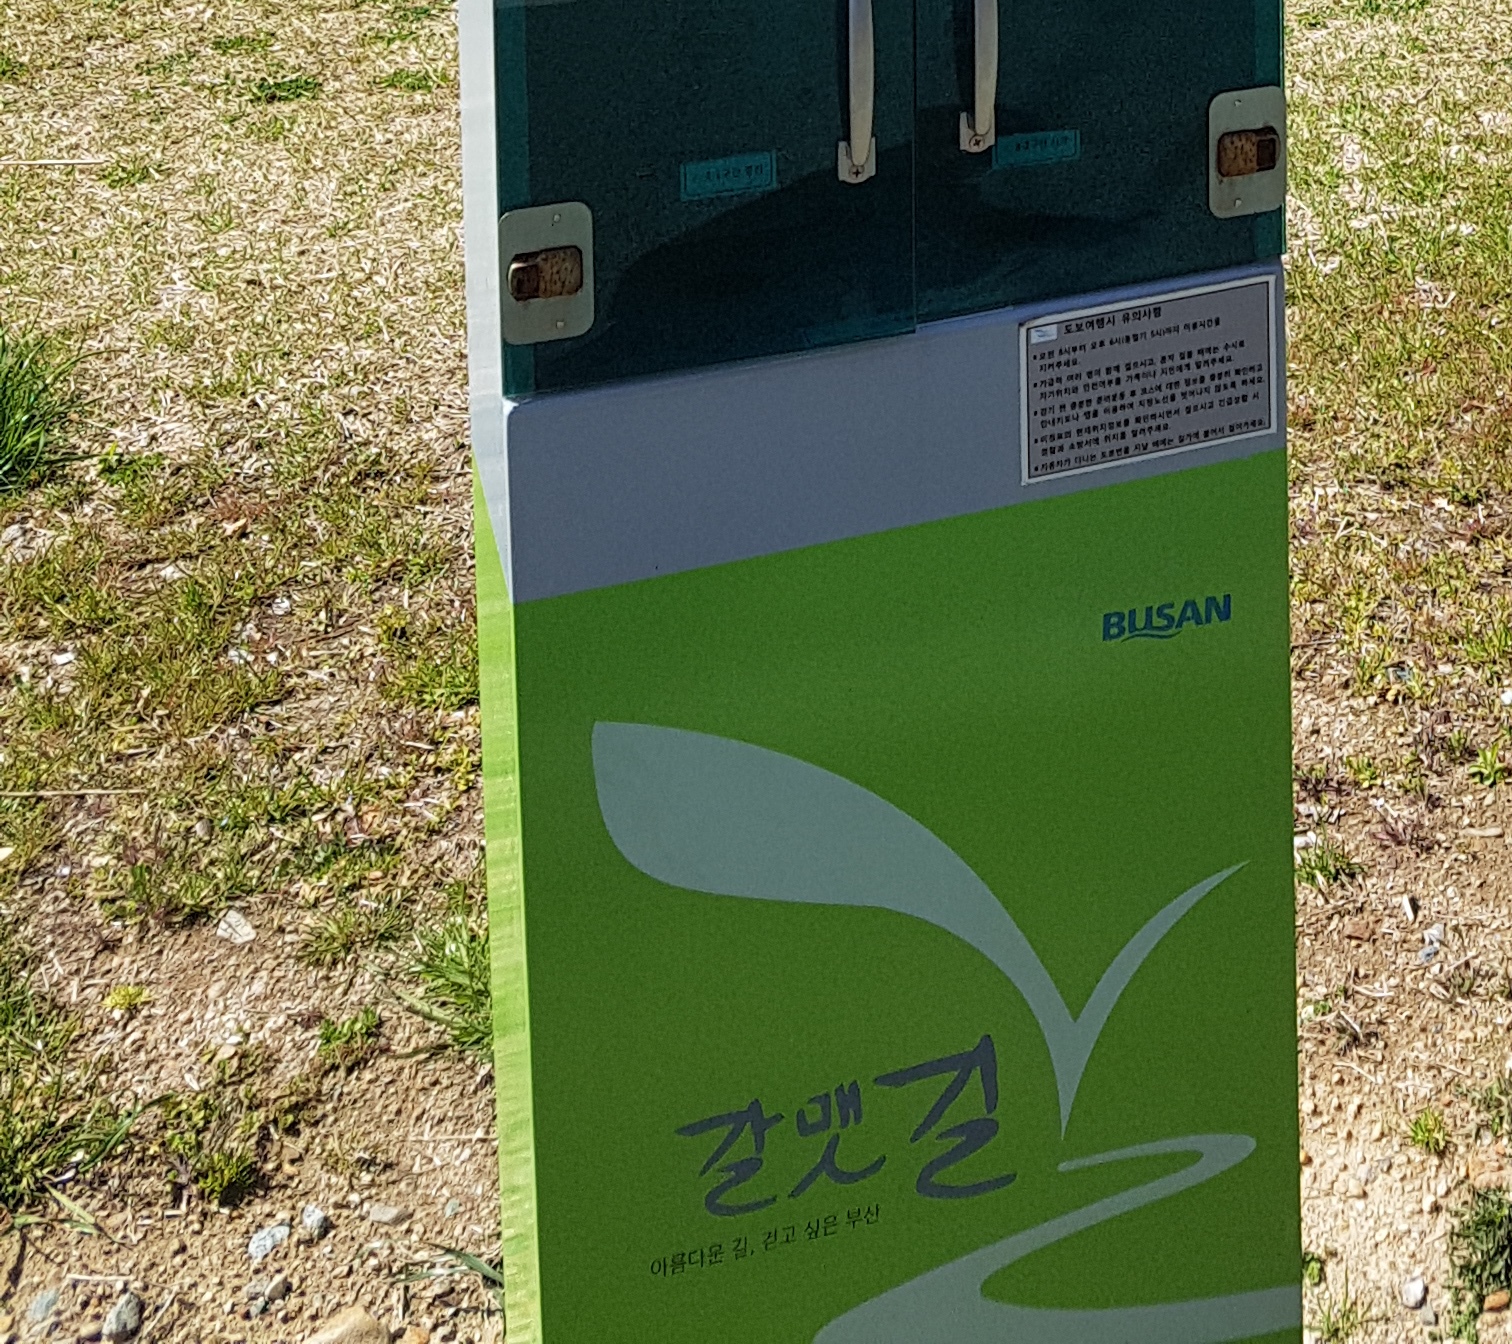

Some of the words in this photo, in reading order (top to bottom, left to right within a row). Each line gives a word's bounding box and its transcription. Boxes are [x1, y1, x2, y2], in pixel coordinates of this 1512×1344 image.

[1102, 593, 1231, 641] BUSAN
[674, 1034, 1017, 1217] 갈맷길
[651, 1244, 724, 1277] 아름다운
[732, 1237, 754, 1261] 길,
[763, 1226, 795, 1251] 걷고
[804, 1214, 837, 1240] 싶은
[846, 1203, 879, 1229] 부산
